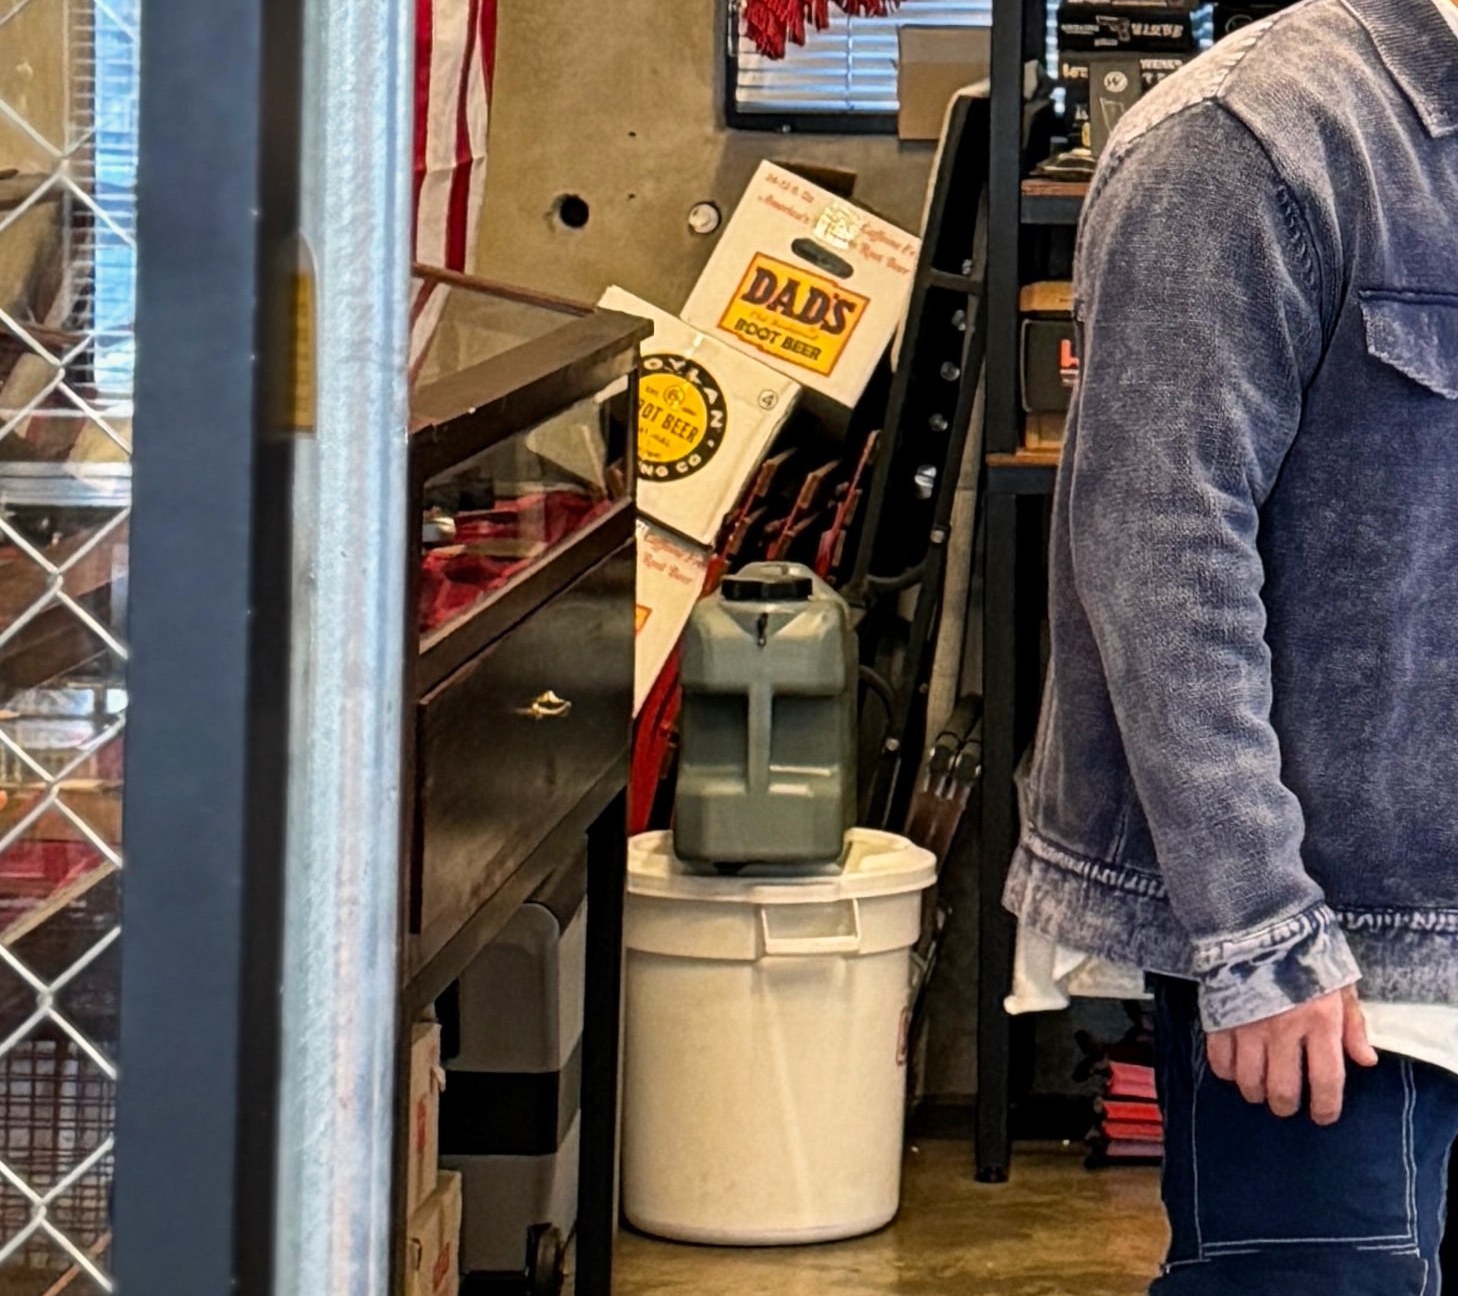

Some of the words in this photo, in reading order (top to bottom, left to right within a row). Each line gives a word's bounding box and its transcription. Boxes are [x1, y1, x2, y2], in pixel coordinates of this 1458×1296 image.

[740, 265, 858, 336] DAD'S
[734, 317, 782, 345] ROOT
[780, 334, 823, 361] BEER
[643, 357, 724, 429] OYLAN
[661, 413, 699, 444] BEER
